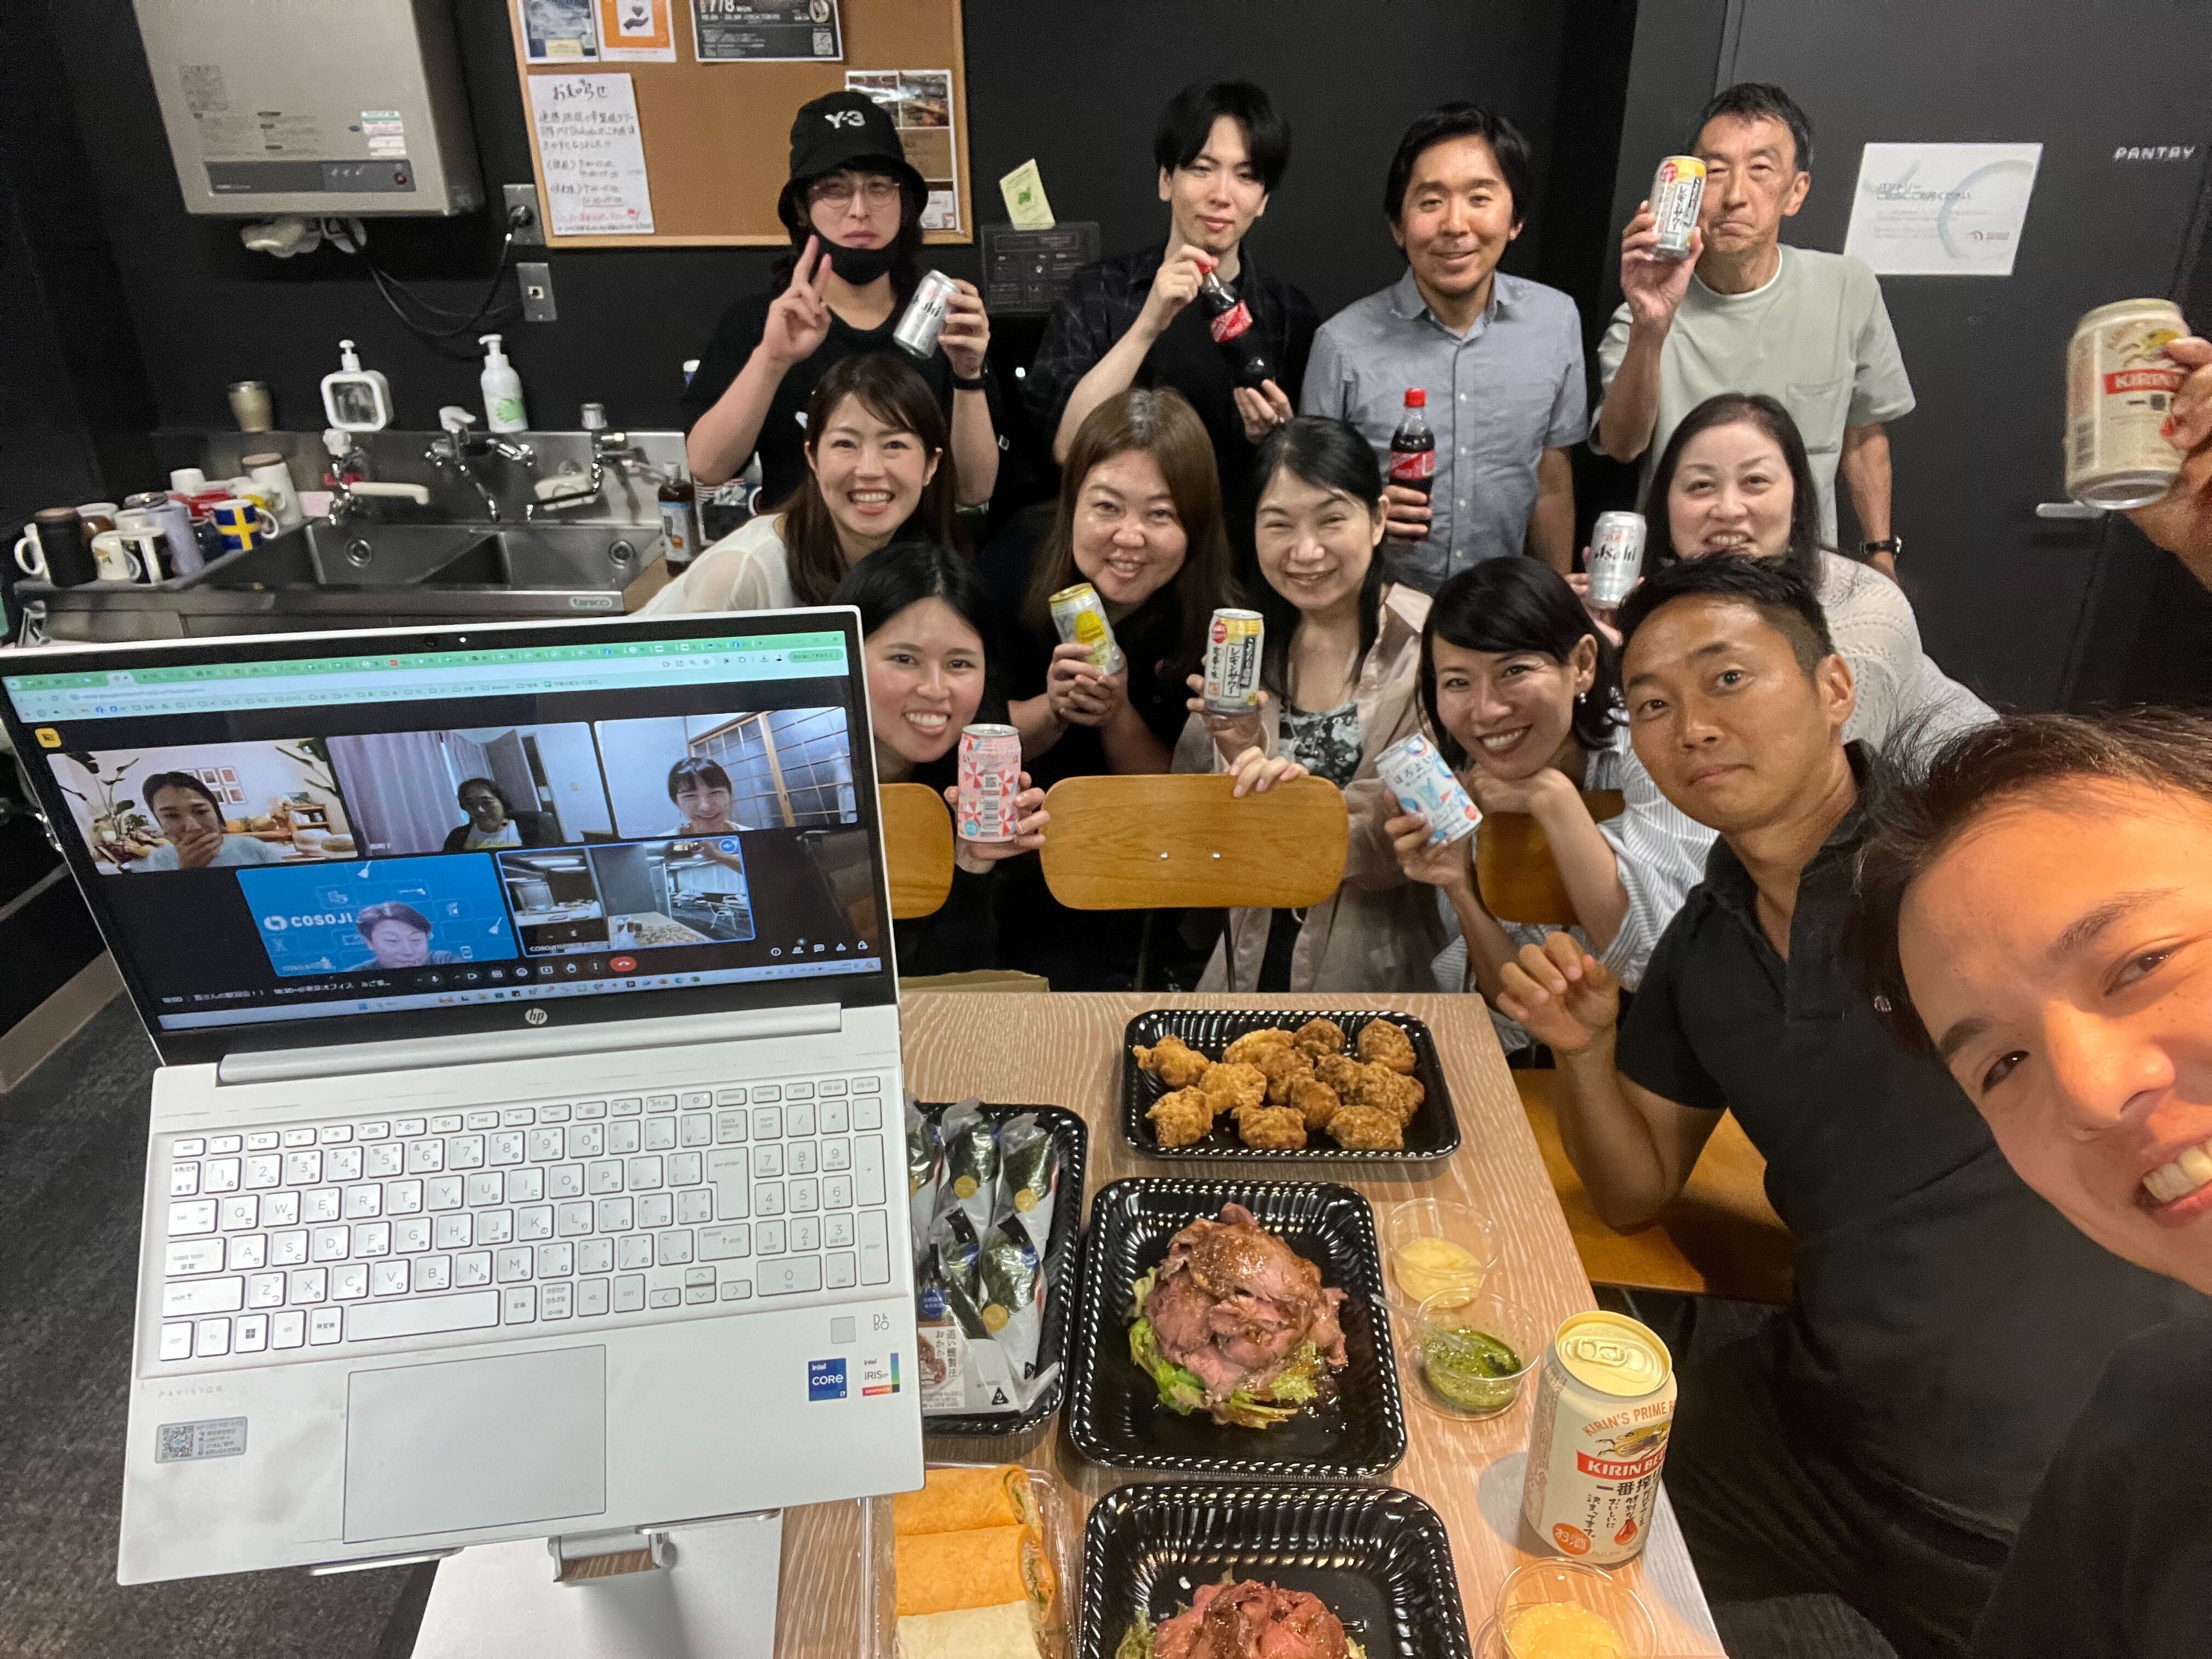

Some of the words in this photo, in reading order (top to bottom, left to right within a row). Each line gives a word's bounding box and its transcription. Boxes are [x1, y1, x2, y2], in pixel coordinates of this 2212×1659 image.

[825, 110, 865, 128] Y-3
[2114, 145, 2195, 161] PANTRY
[291, 912, 352, 927] COSOJI
[528, 1008, 545, 1025] hp
[503, 1143, 511, 1153] 8
[543, 1138, 550, 1149] 9
[422, 1150, 430, 1161] 6
[463, 1147, 470, 1157] 7
[831, 1148, 839, 1159] 9
[341, 1159, 348, 1167] 4
[381, 1154, 390, 1165] 5
[764, 1155, 771, 1165] 7
[798, 1152, 806, 1164] 8
[259, 1166, 267, 1177] 2
[300, 1162, 308, 1173] 3
[221, 1170, 224, 1181] 1
[601, 1172, 610, 1182] P
[441, 1187, 450, 1197] Y
[481, 1184, 490, 1194] U
[833, 1186, 840, 1198] 6
[401, 1192, 408, 1202] T
[765, 1193, 772, 1203] 4
[800, 1189, 807, 1200] 5
[318, 1200, 326, 1210] E
[359, 1196, 367, 1205] R
[235, 1207, 245, 1217] Q
[275, 1204, 289, 1214] W
[531, 1217, 539, 1228] K
[572, 1214, 578, 1223] L
[450, 1226, 459, 1235] H
[492, 1222, 498, 1232] J
[836, 1224, 842, 1235] 3
[409, 1230, 417, 1240] G
[769, 1232, 772, 1242] 1
[802, 1228, 808, 1239] 2
[325, 1238, 335, 1249] D
[368, 1234, 376, 1245] F
[243, 1247, 252, 1256] A
[285, 1242, 293, 1252] S
[469, 1264, 478, 1273] N
[510, 1260, 520, 1269] M
[386, 1272, 396, 1282] V
[428, 1268, 436, 1278] B
[785, 1269, 793, 1280] 0
[304, 1280, 312, 1290] X
[345, 1276, 354, 1286] C
[263, 1285, 270, 1295] Z
[864, 1370, 882, 1380] IRIS
[996, 1391, 1003, 1403] 2
[1582, 1412, 1630, 1437] KIRIN'S
[1633, 1402, 1667, 1421] PRIME
[1588, 1460, 1642, 1476] KIRIN
